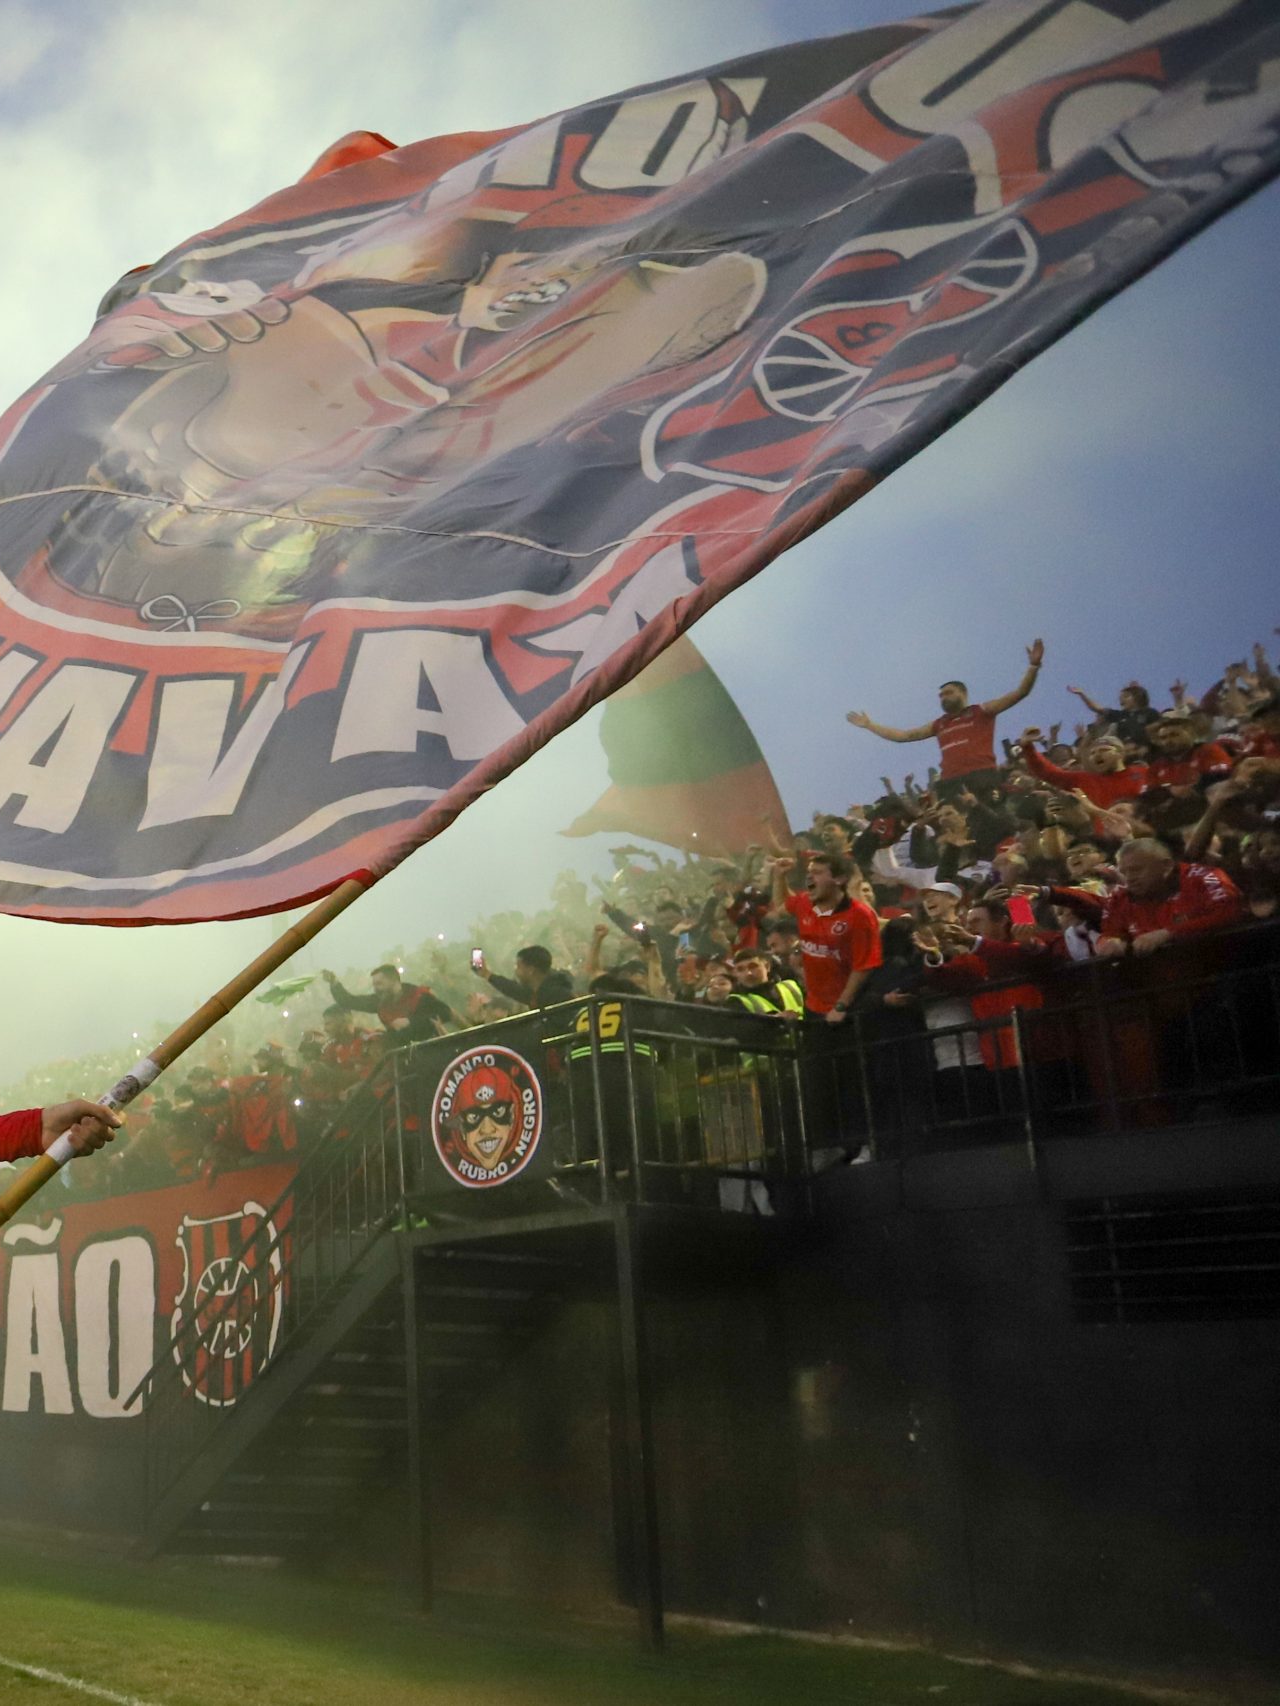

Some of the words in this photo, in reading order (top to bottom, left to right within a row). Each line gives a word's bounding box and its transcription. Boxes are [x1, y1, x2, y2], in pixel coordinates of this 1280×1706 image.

[439, 1054, 495, 1123] COMANDO
[458, 1159, 508, 1181] RUBRO
[515, 1088, 536, 1156] NEGRO
